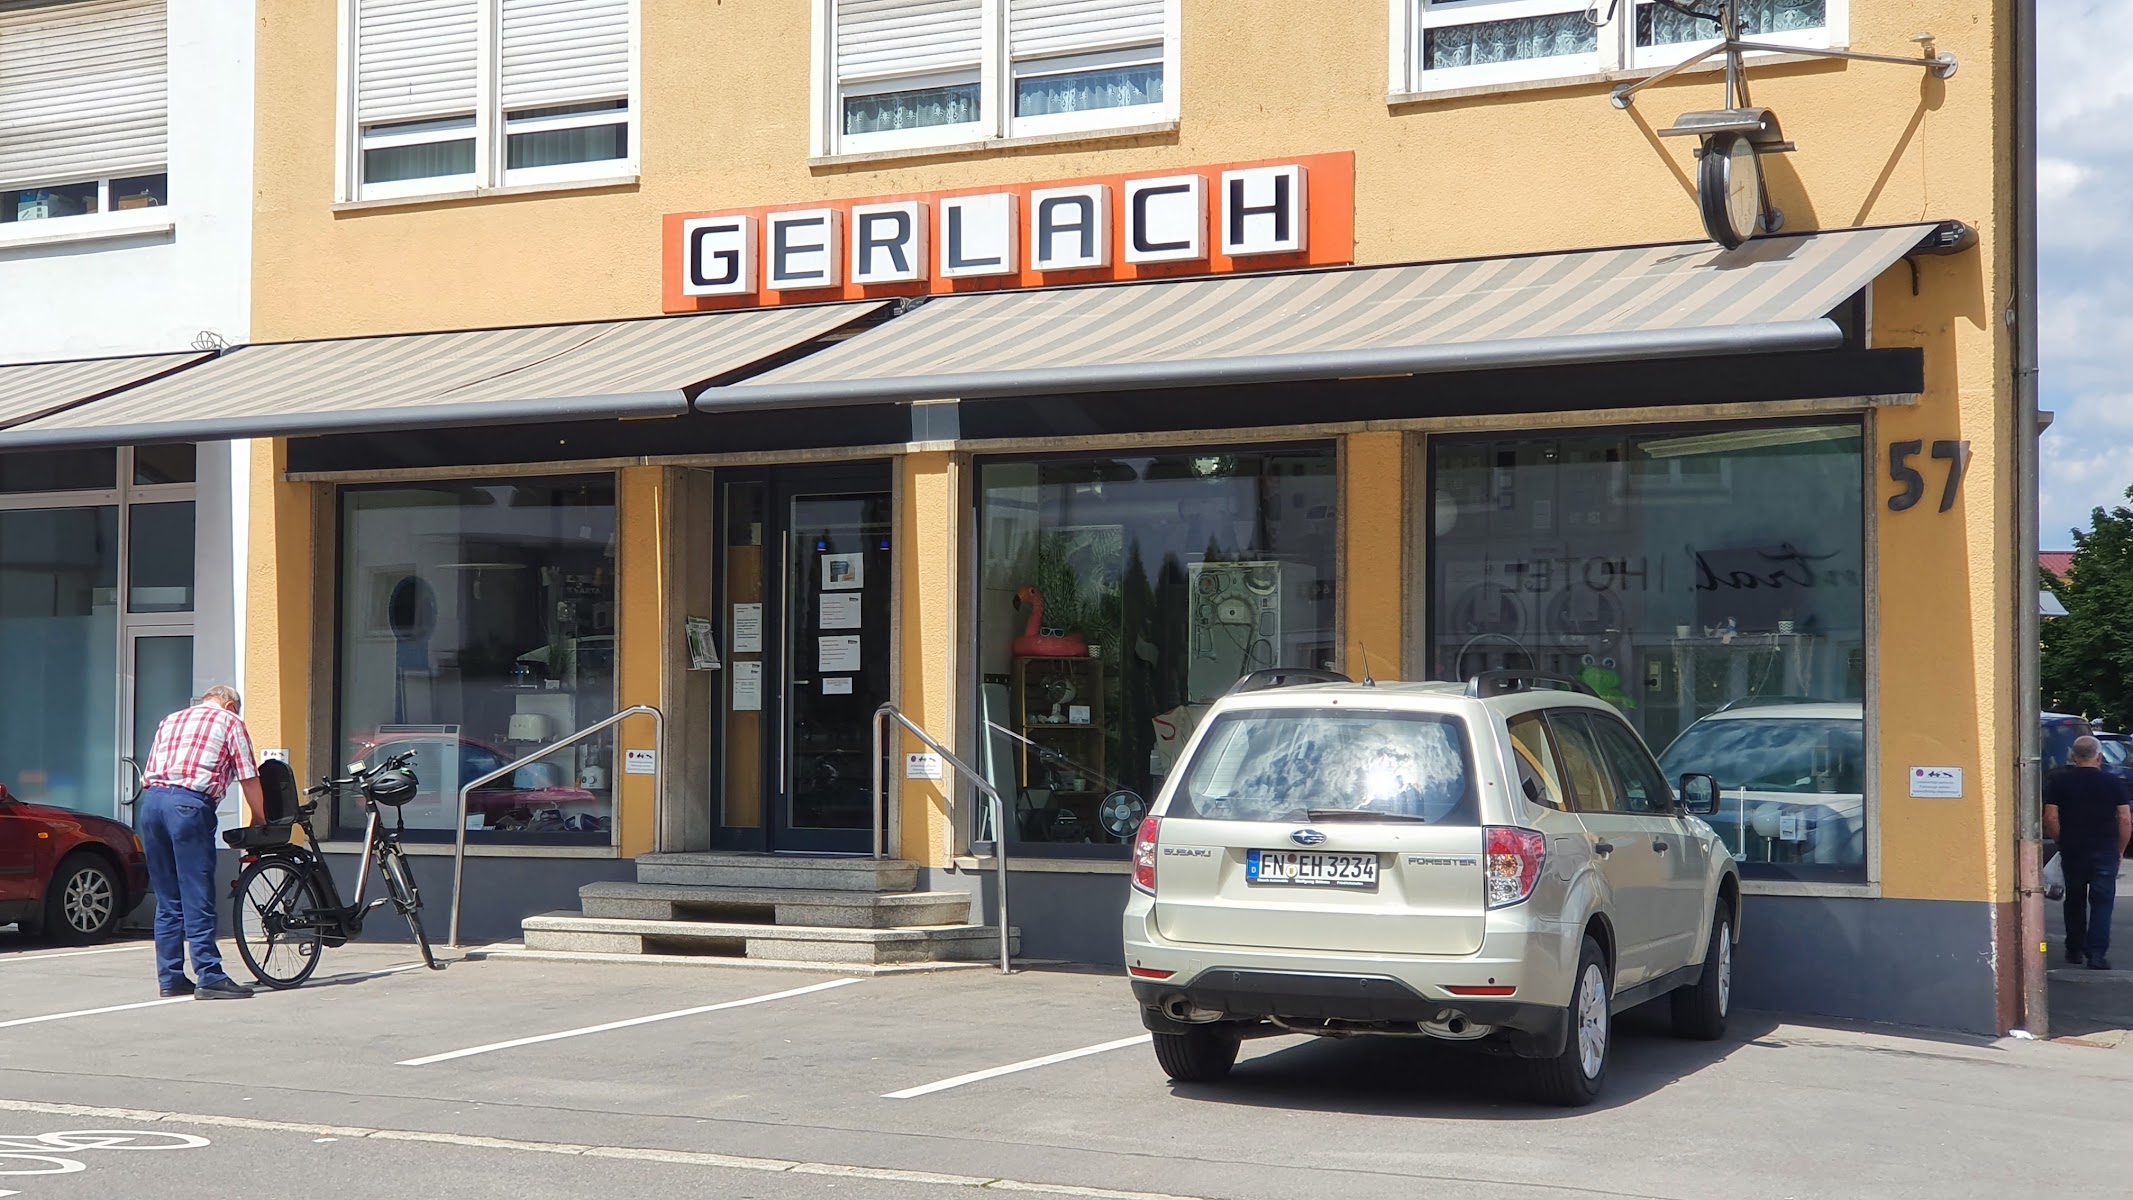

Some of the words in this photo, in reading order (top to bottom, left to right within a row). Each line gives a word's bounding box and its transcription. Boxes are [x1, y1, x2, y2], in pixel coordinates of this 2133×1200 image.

[690, 174, 1290, 287] GERLACH
[1888, 439, 1970, 513] 57
[1163, 848, 1212, 858] SUBARU
[1408, 856, 1477, 866] FORESTER
[1261, 854, 1285, 875] FN
[1299, 855, 1323, 877] EH
[1327, 856, 1374, 878] 3234
